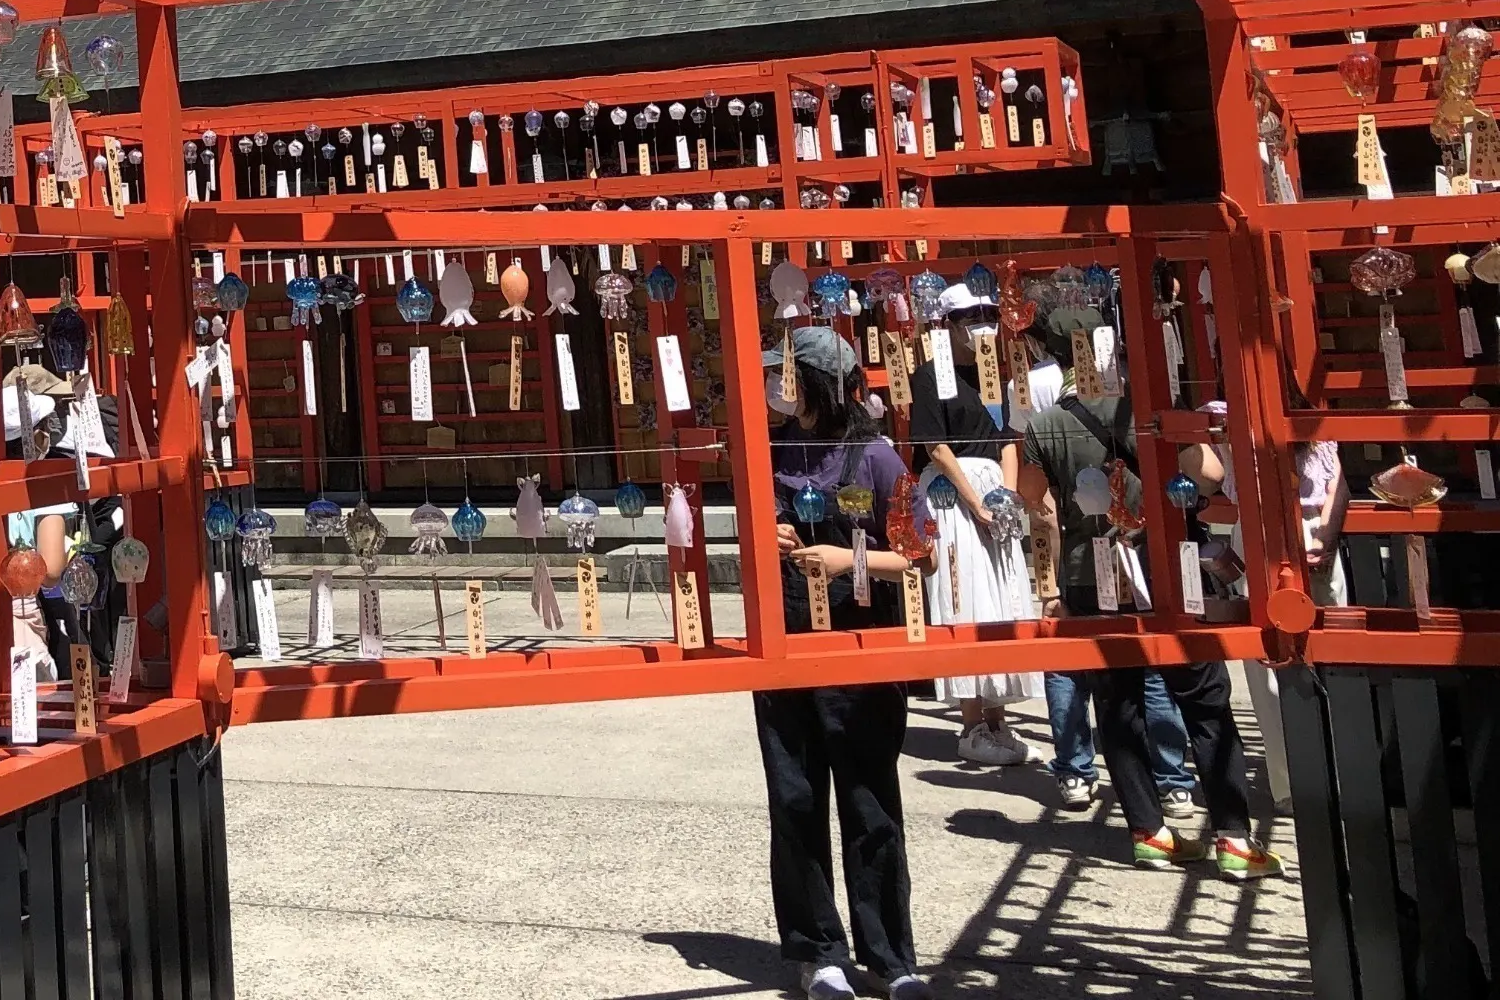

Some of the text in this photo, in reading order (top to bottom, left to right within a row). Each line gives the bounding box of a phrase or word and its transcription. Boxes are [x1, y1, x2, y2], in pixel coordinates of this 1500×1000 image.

[704, 275, 717, 312] 風鈴まつり
[621, 360, 630, 400] 白山神社
[891, 358, 903, 400] 白山神社
[984, 359, 996, 400] 白山神社
[1016, 366, 1027, 406] 白山神社
[1077, 355, 1087, 395] 白山神社
[1039, 552, 1050, 592] 白山神社
[584, 587, 593, 631] 白山神社
[685, 600, 697, 643] 白山神社
[814, 582, 825, 625] 白山神社
[910, 595, 920, 637] 白山神社
[472, 609, 481, 653] 白山神社
[80, 677, 90, 728] 白山神社
